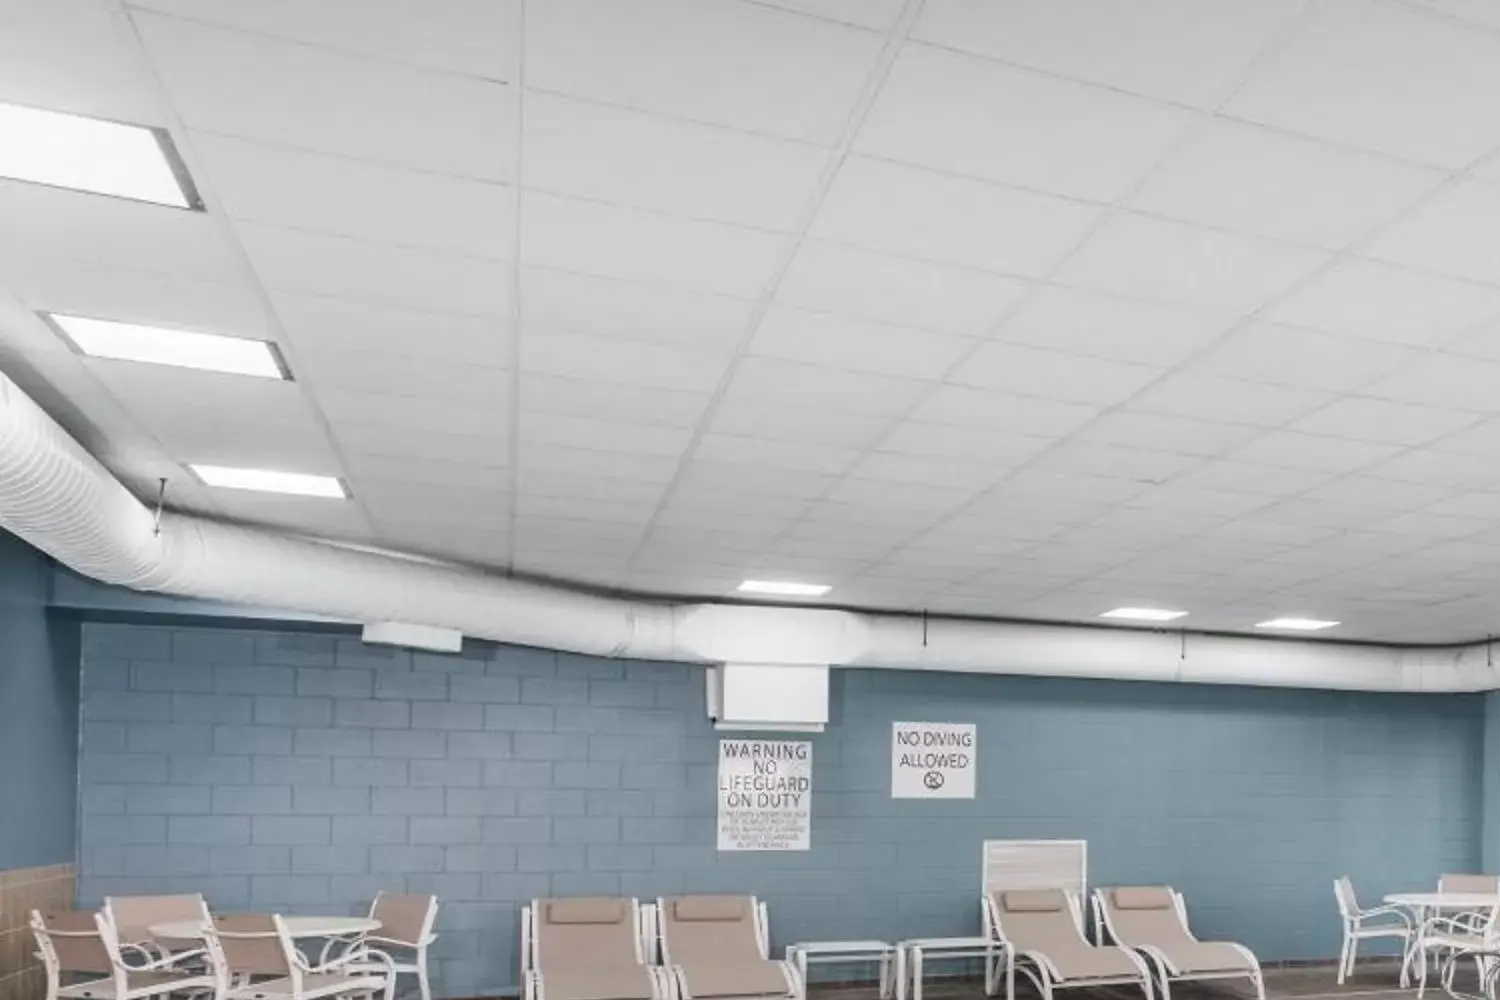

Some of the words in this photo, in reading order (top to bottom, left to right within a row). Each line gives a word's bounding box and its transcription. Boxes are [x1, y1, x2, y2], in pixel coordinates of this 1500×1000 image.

[897, 731, 920, 746] NO
[923, 731, 972, 747] DIVING
[723, 743, 807, 760] WARNING
[753, 760, 777, 774] NO
[900, 753, 969, 768] ALLOWED
[720, 775, 809, 792] LIFEGUARD
[727, 792, 751, 807] ON
[757, 792, 801, 808] DUTY
